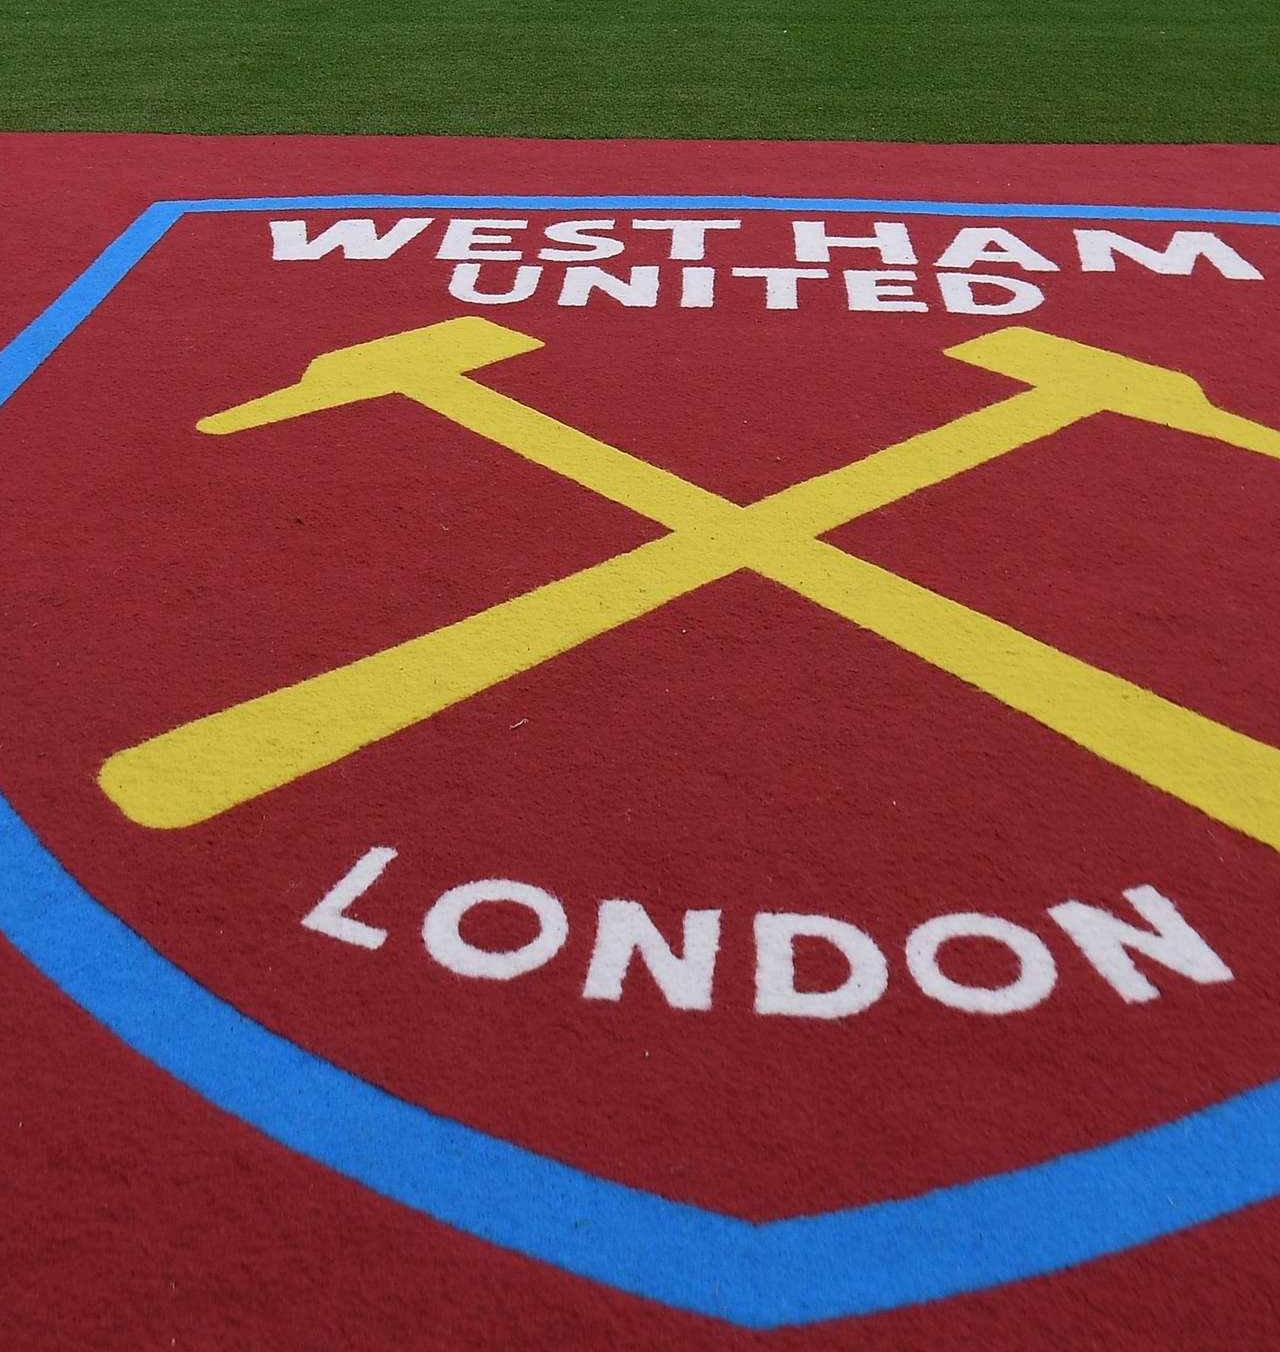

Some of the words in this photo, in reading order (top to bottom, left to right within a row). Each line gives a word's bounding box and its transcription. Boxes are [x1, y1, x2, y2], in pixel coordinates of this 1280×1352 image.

[270, 217, 741, 262] WEST
[794, 219, 1263, 281] HAM
[448, 264, 1045, 316] UNITED
[301, 847, 1234, 1020] LONDON
